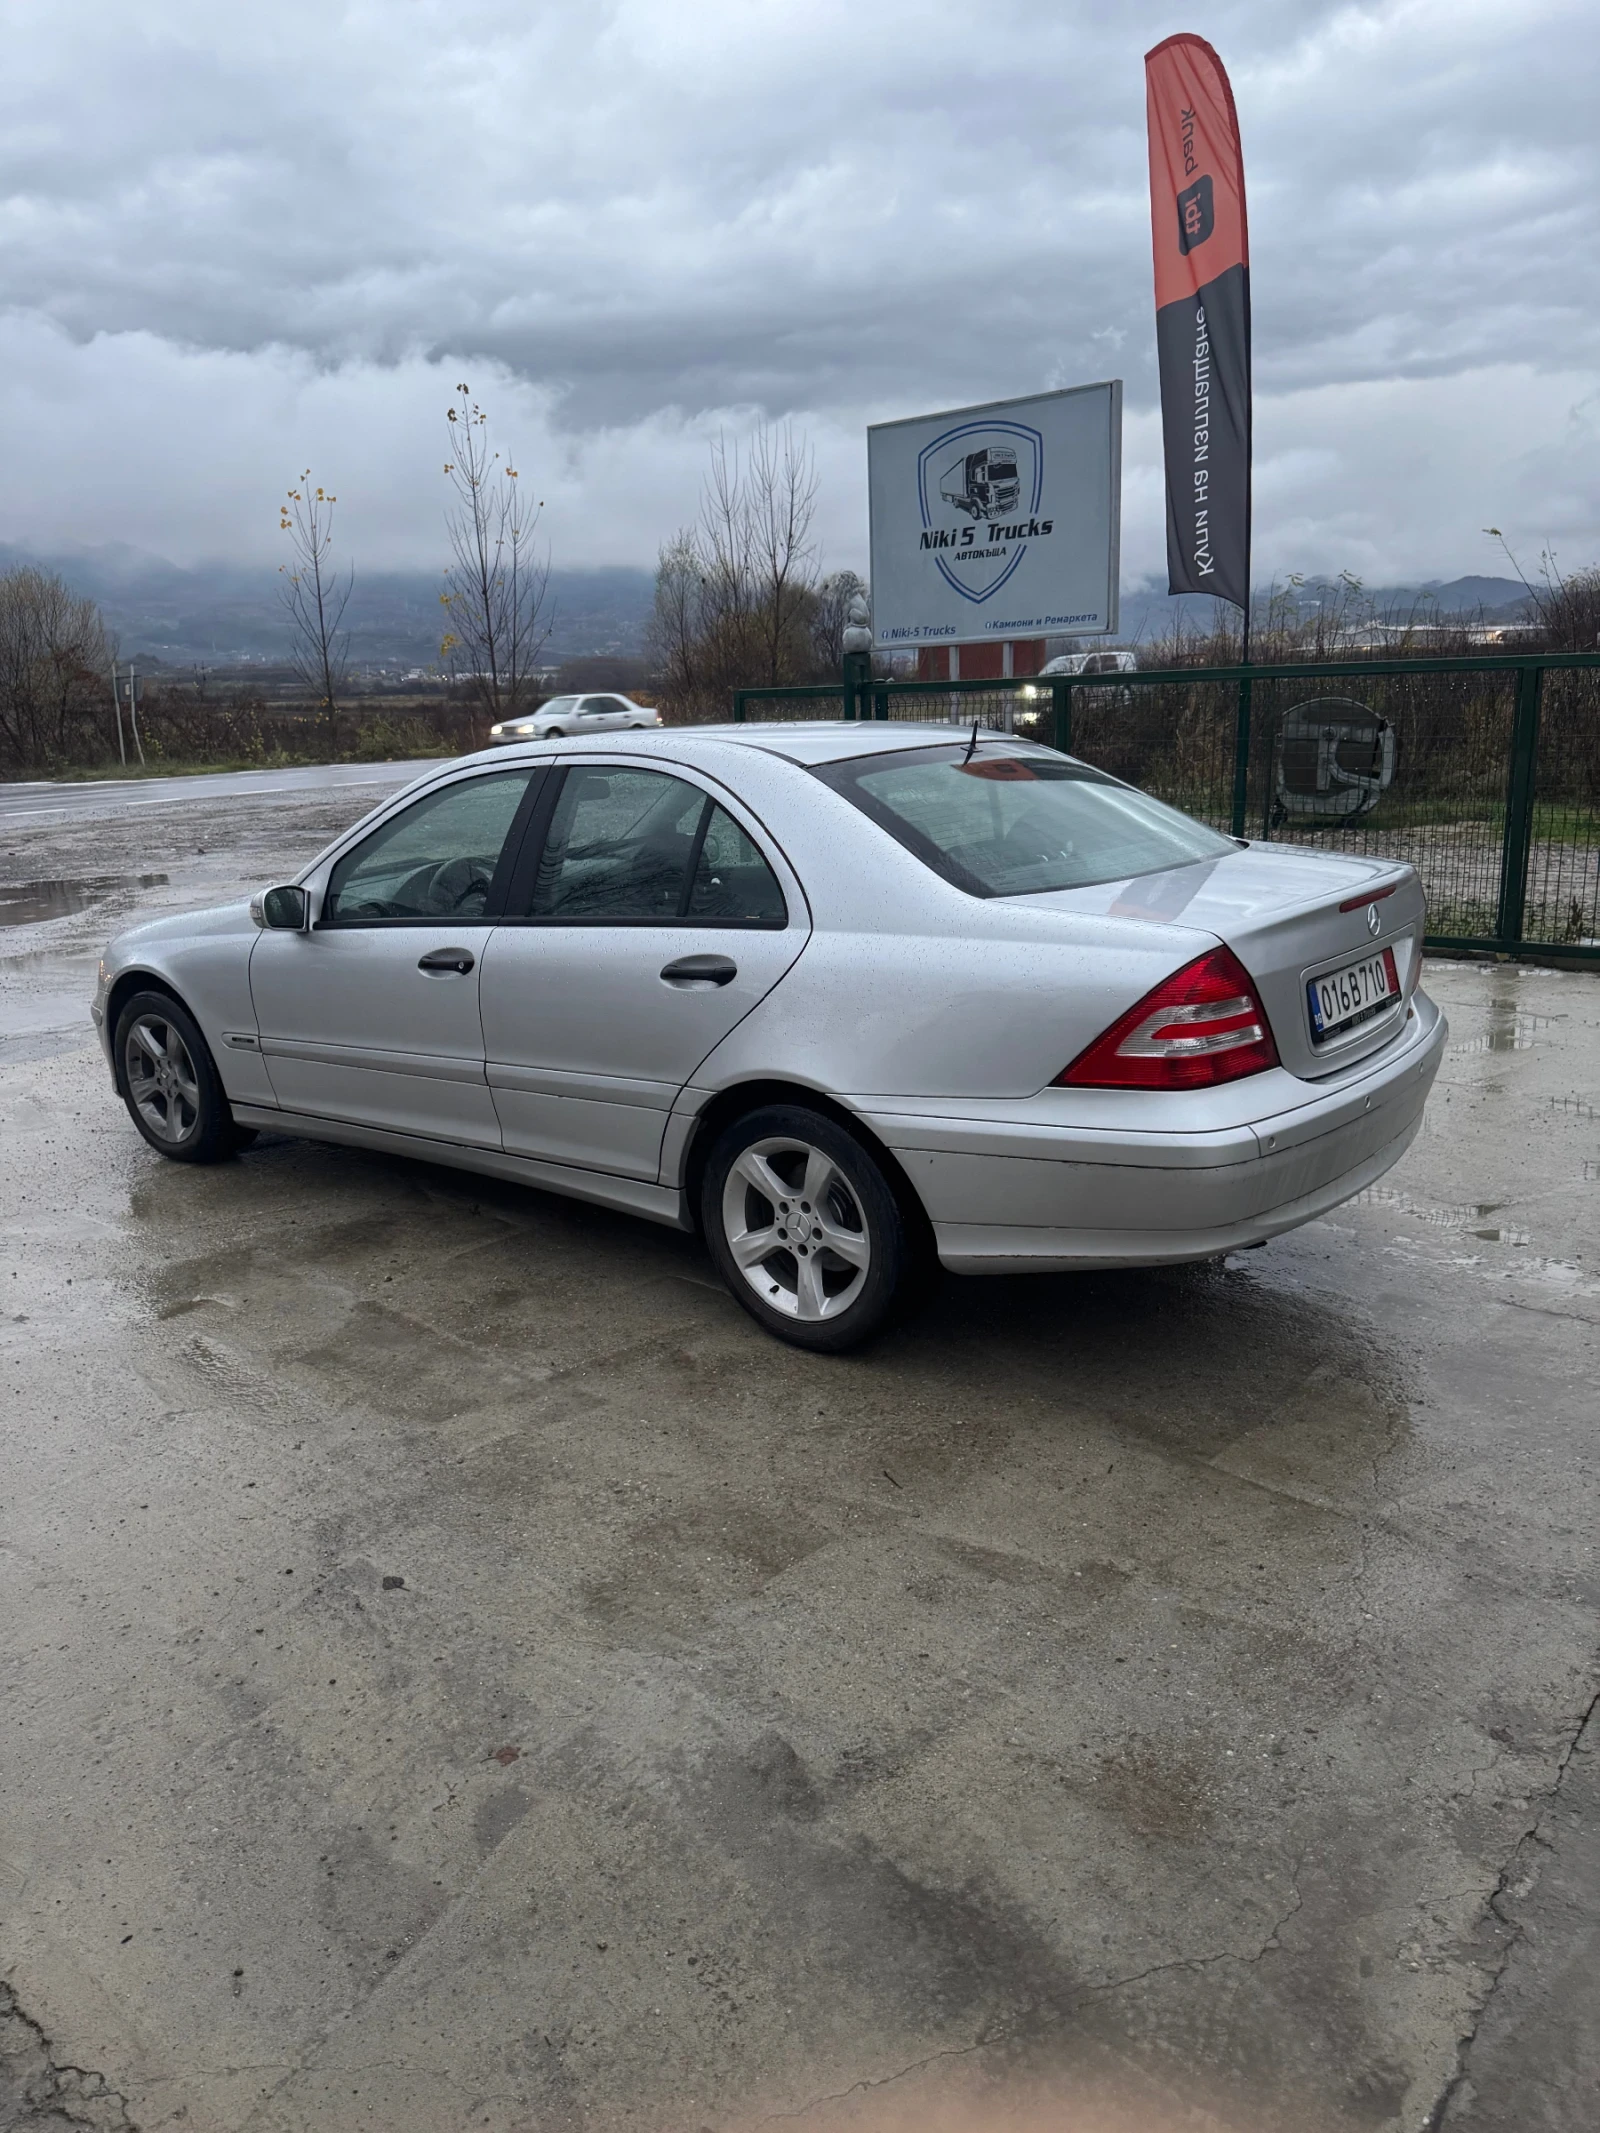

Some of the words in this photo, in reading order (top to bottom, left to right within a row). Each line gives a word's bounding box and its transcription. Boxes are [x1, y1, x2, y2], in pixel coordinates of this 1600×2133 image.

[919, 528, 957, 551] Niki
[987, 518, 1054, 542] Trucks
[992, 618, 1033, 630] Камиони
[1036, 618, 1042, 626] и
[1044, 613, 1098, 626] Ремаркета
[923, 624, 956, 637] Trucks
[1314, 1013, 1324, 1025] BG
